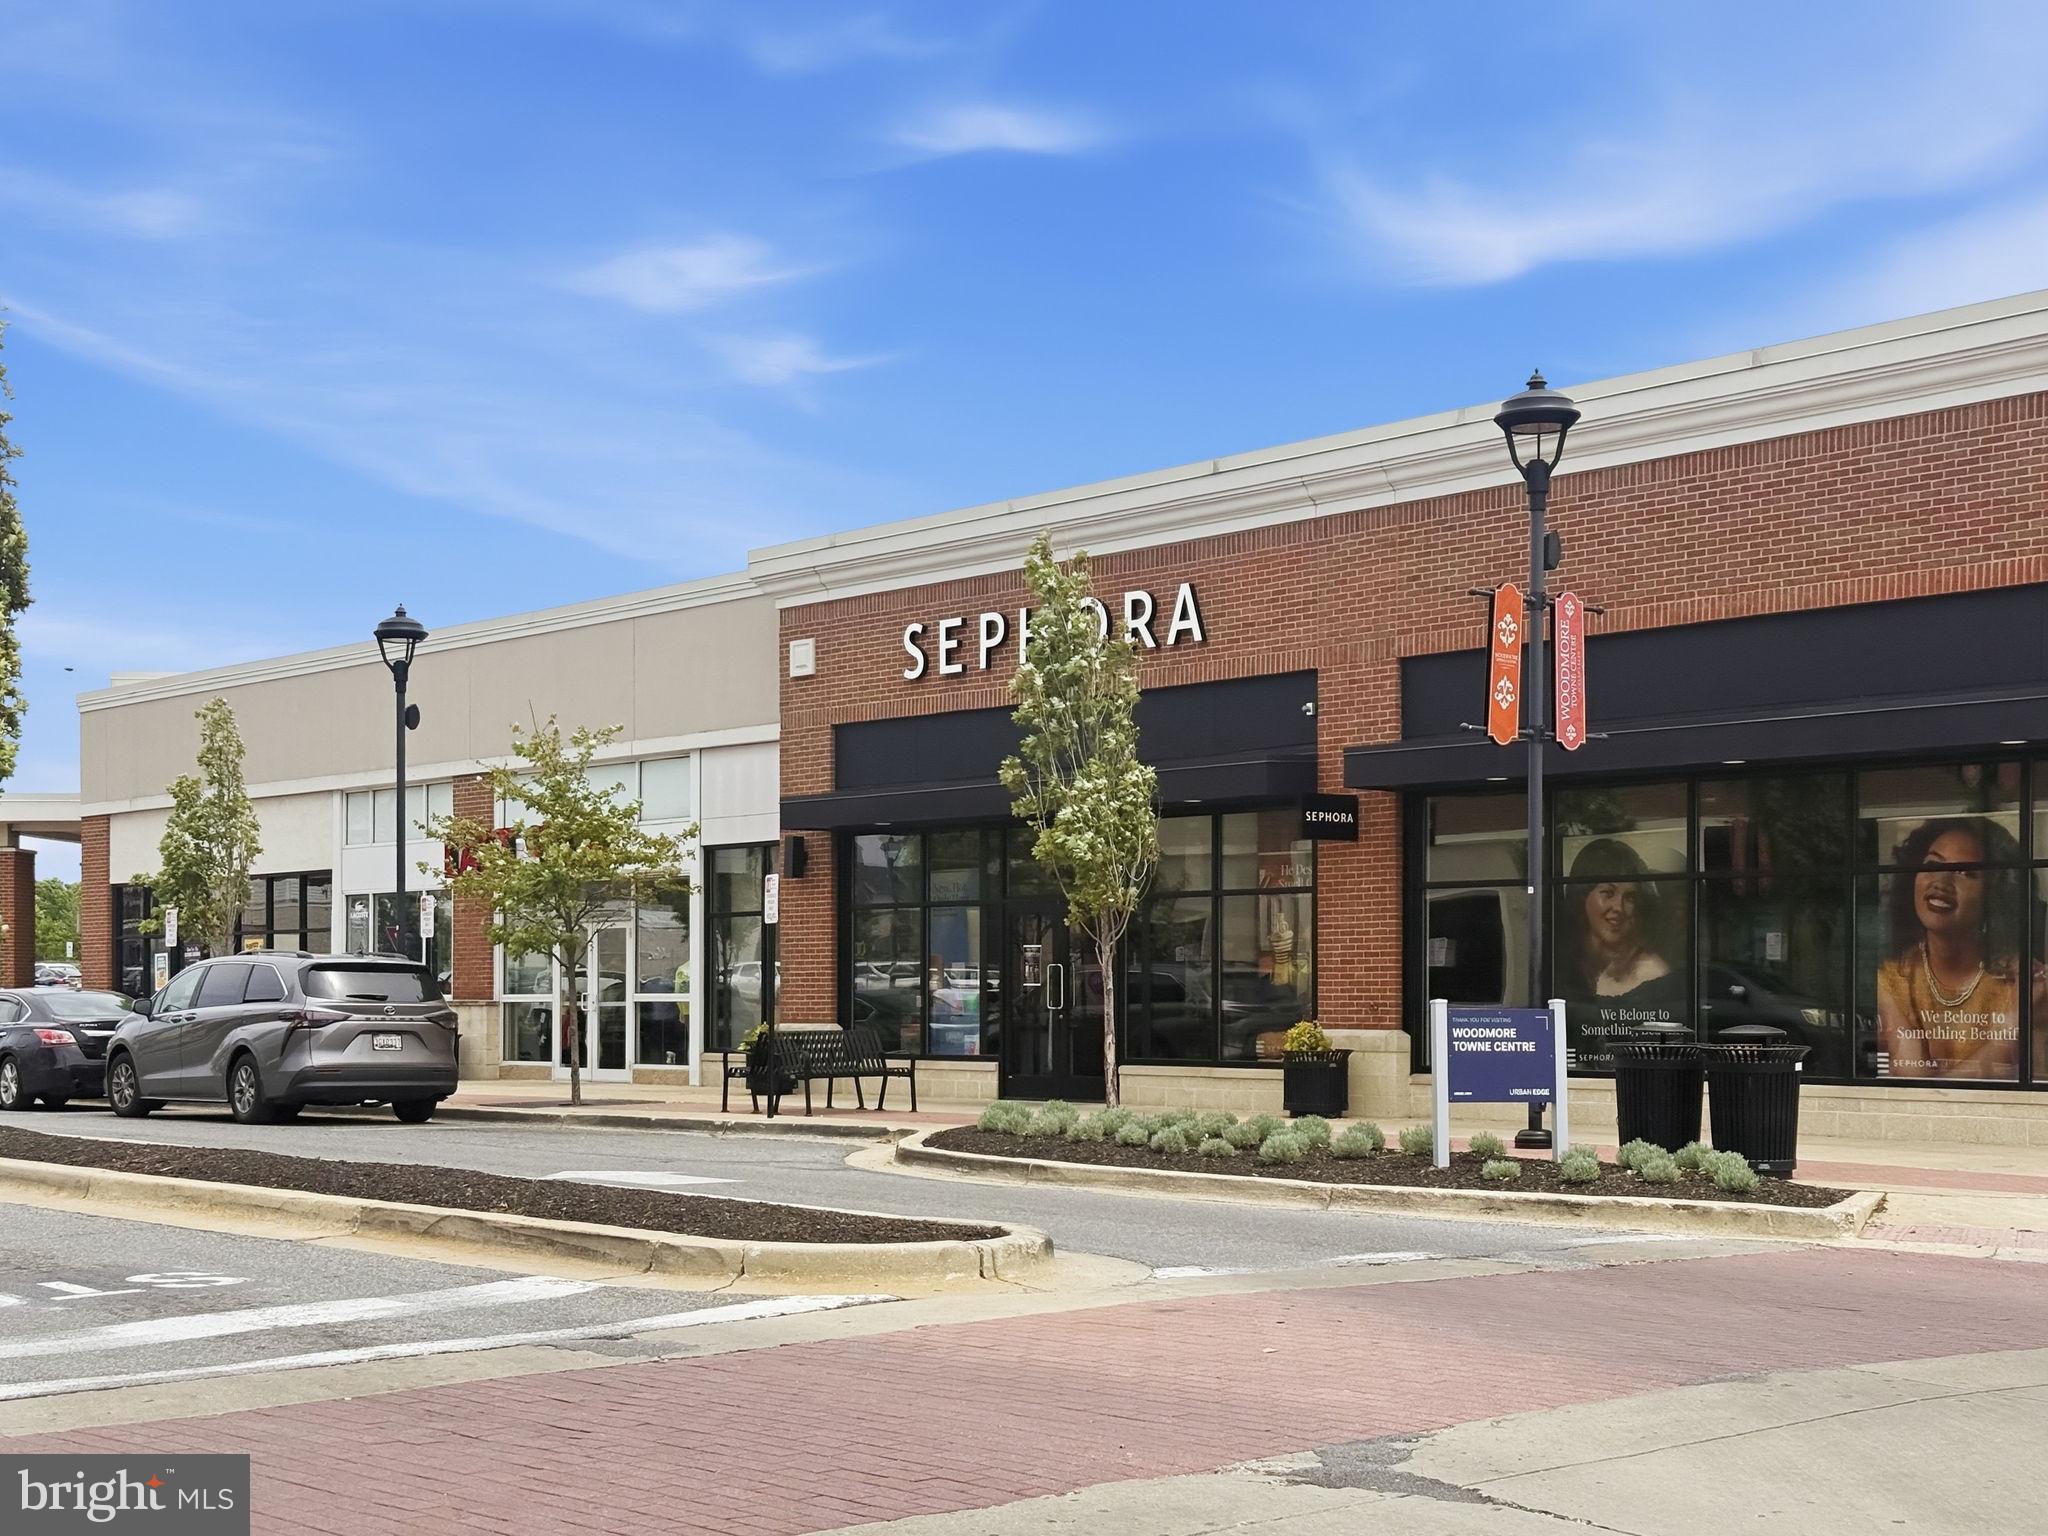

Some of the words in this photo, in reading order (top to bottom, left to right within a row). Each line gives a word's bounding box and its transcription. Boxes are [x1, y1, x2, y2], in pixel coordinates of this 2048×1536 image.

[1570, 634, 1578, 672] CENTRE
[1560, 619, 1571, 721] WOODMORE
[1570, 673, 1578, 708] TOWNE
[1305, 811, 1354, 823] SEPHORA
[1600, 1008, 1617, 1020] We
[1619, 1007, 1656, 1022] Belong
[1658, 1009, 1670, 1020] to
[1920, 1010, 1940, 1023] We
[1944, 1009, 1989, 1025] Belong
[1992, 1011, 2006, 1024] to
[1452, 1027, 1517, 1038] WOODMORE
[1896, 1025, 1966, 1042] Something
[1453, 1041, 1492, 1052] TOWNE
[1494, 1041, 1536, 1052] CENTRE
[1893, 1059, 1938, 1068] SEPHORA
[1509, 1088, 1532, 1096] URBAN
[1533, 1088, 1550, 1096] EDGE
